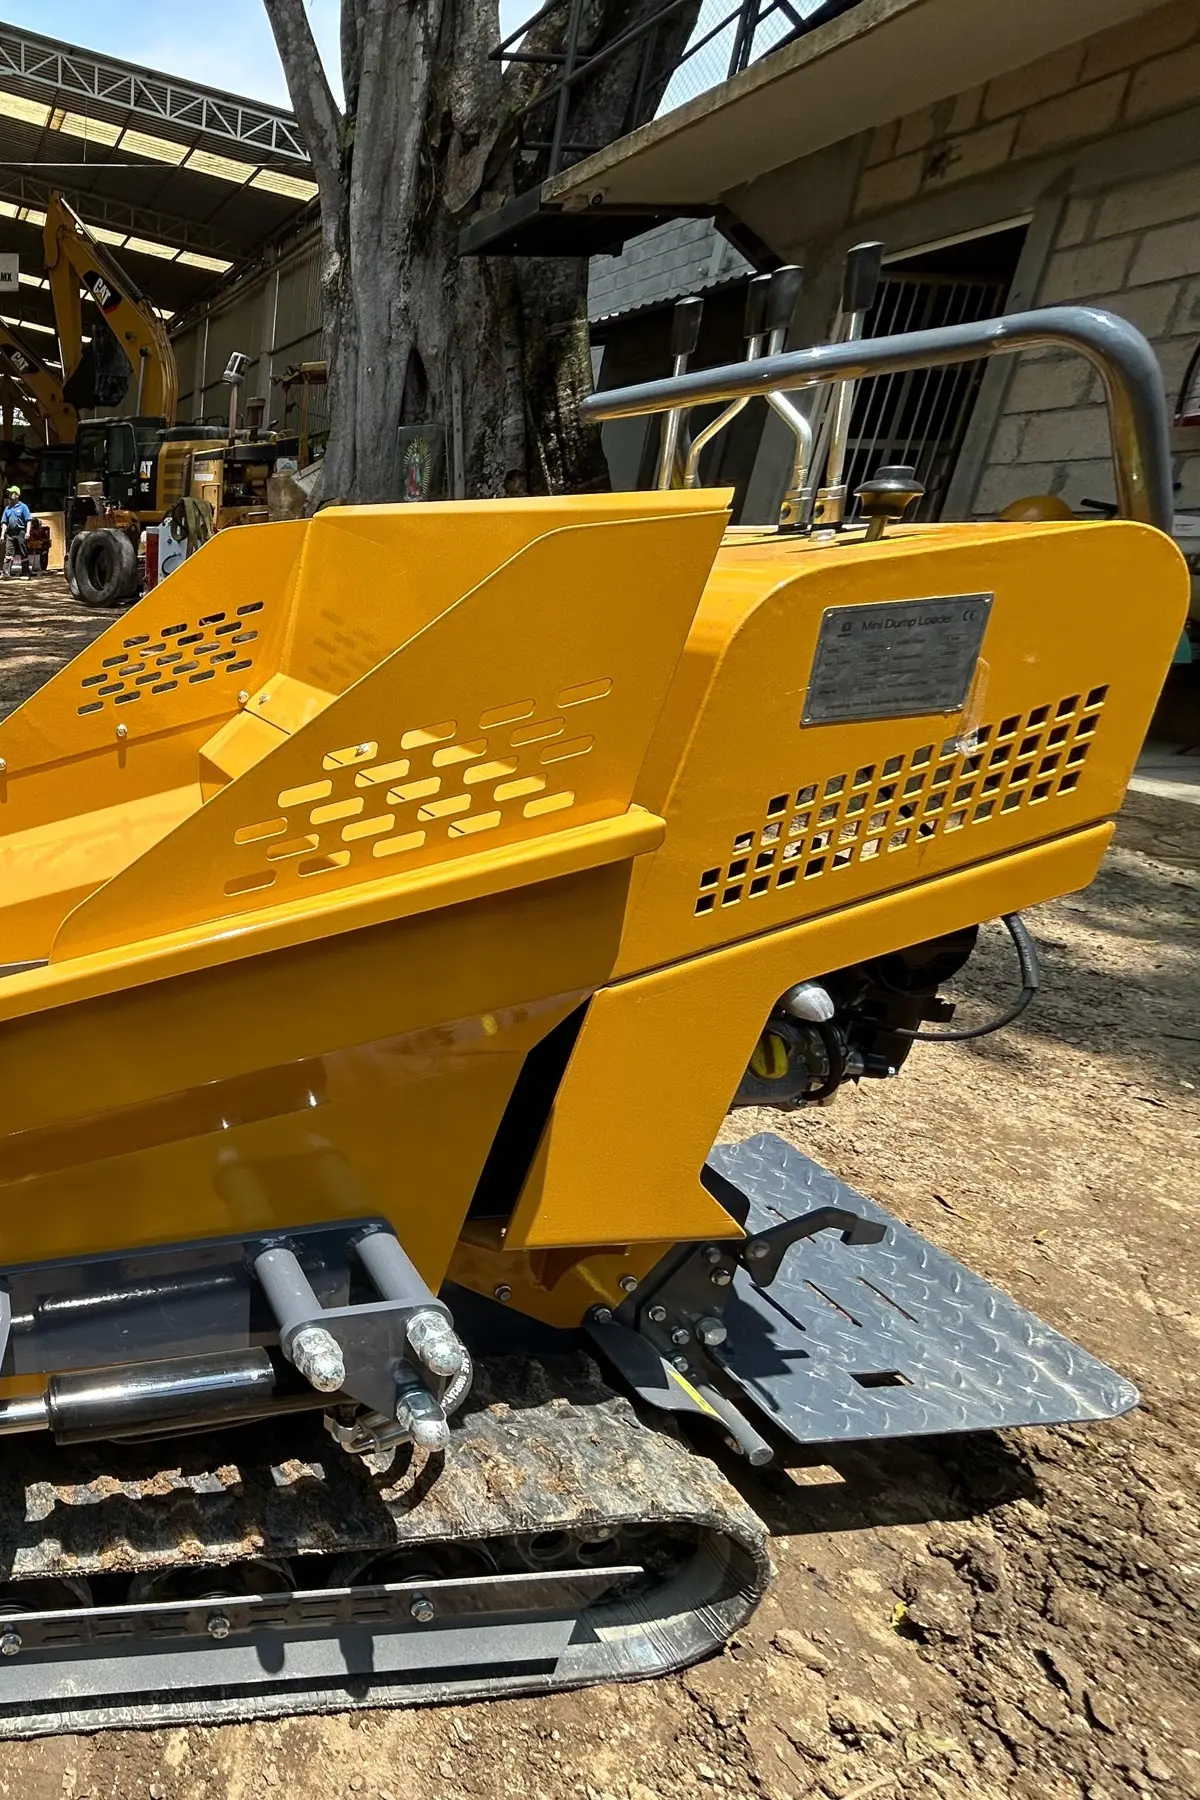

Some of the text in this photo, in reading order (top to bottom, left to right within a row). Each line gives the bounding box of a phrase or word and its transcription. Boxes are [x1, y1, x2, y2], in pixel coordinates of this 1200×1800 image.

[93, 277, 111, 306] CAT
[10, 351, 29, 371] CAT
[140, 461, 153, 478] AT
[861, 620, 883, 631] Mini
[885, 617, 916, 630] Dump
[918, 613, 955, 626] Loader
